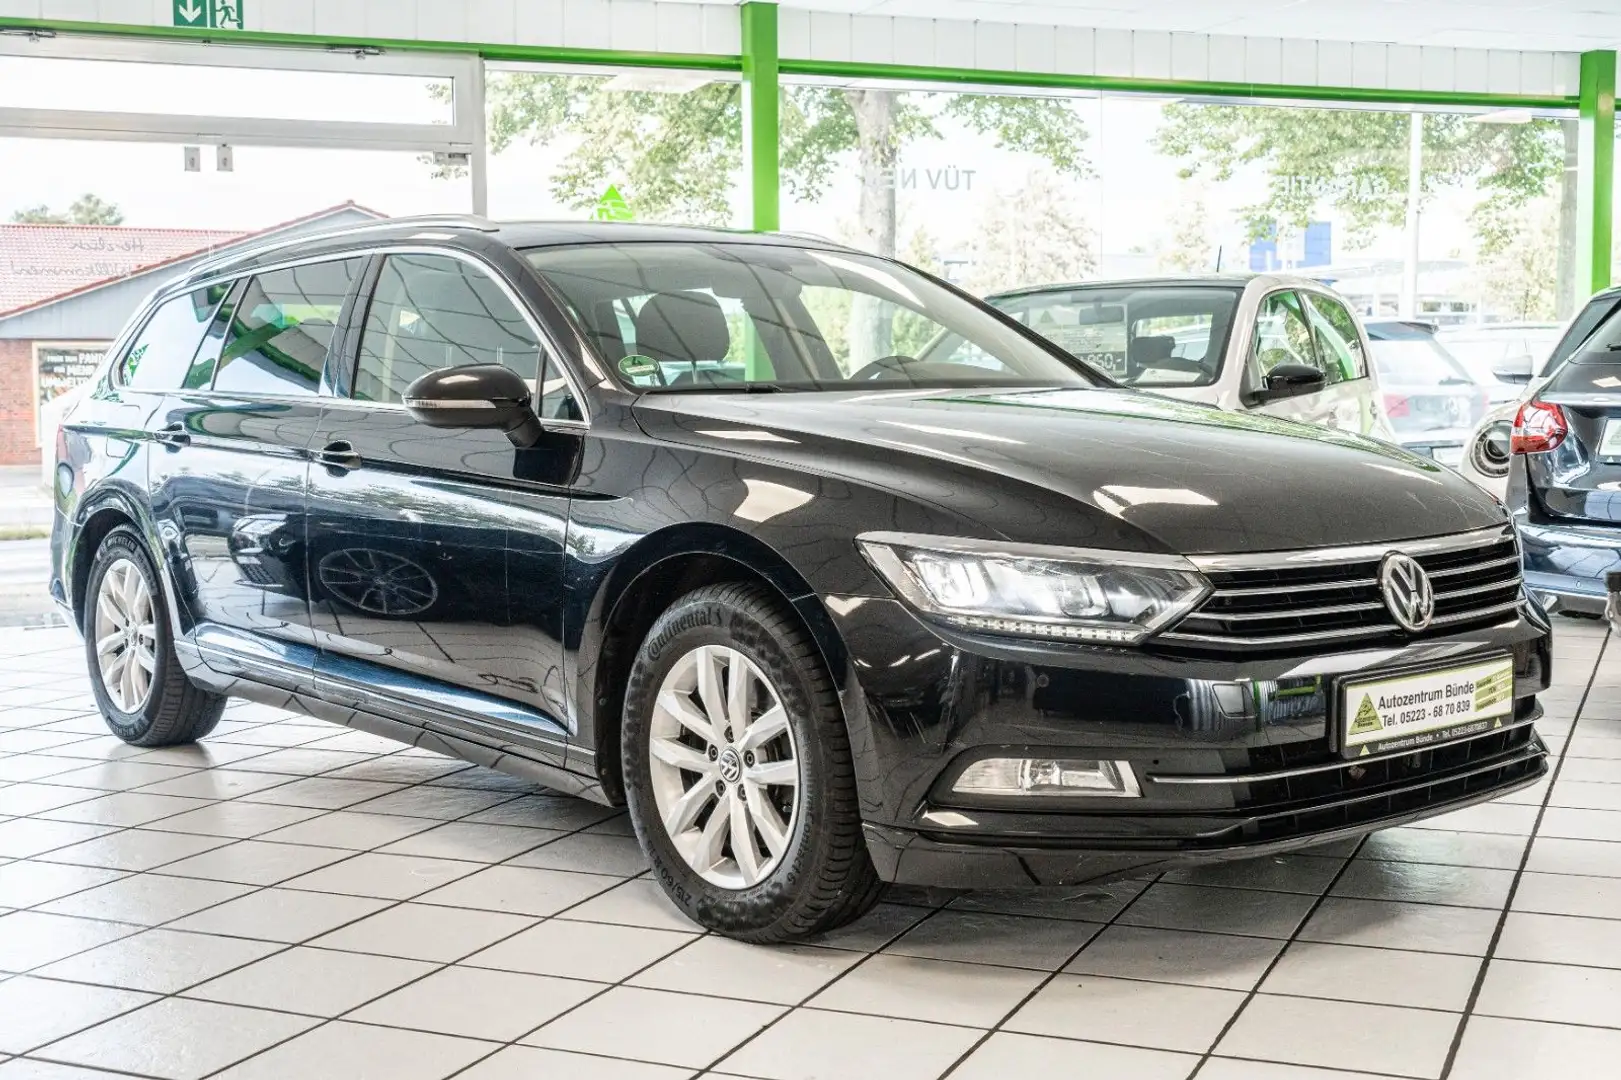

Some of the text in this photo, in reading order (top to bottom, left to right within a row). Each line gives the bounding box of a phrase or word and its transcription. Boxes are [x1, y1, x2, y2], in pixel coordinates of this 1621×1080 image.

[647, 606, 712, 661] Continental
[1378, 690, 1443, 710] Autozentrum
[1445, 681, 1475, 698] Bünde
[1382, 713, 1398, 727] Tel.
[1400, 708, 1426, 724] 05223
[1433, 704, 1443, 718] 68
[1445, 702, 1455, 716] 70
[1456, 699, 1471, 713] 839
